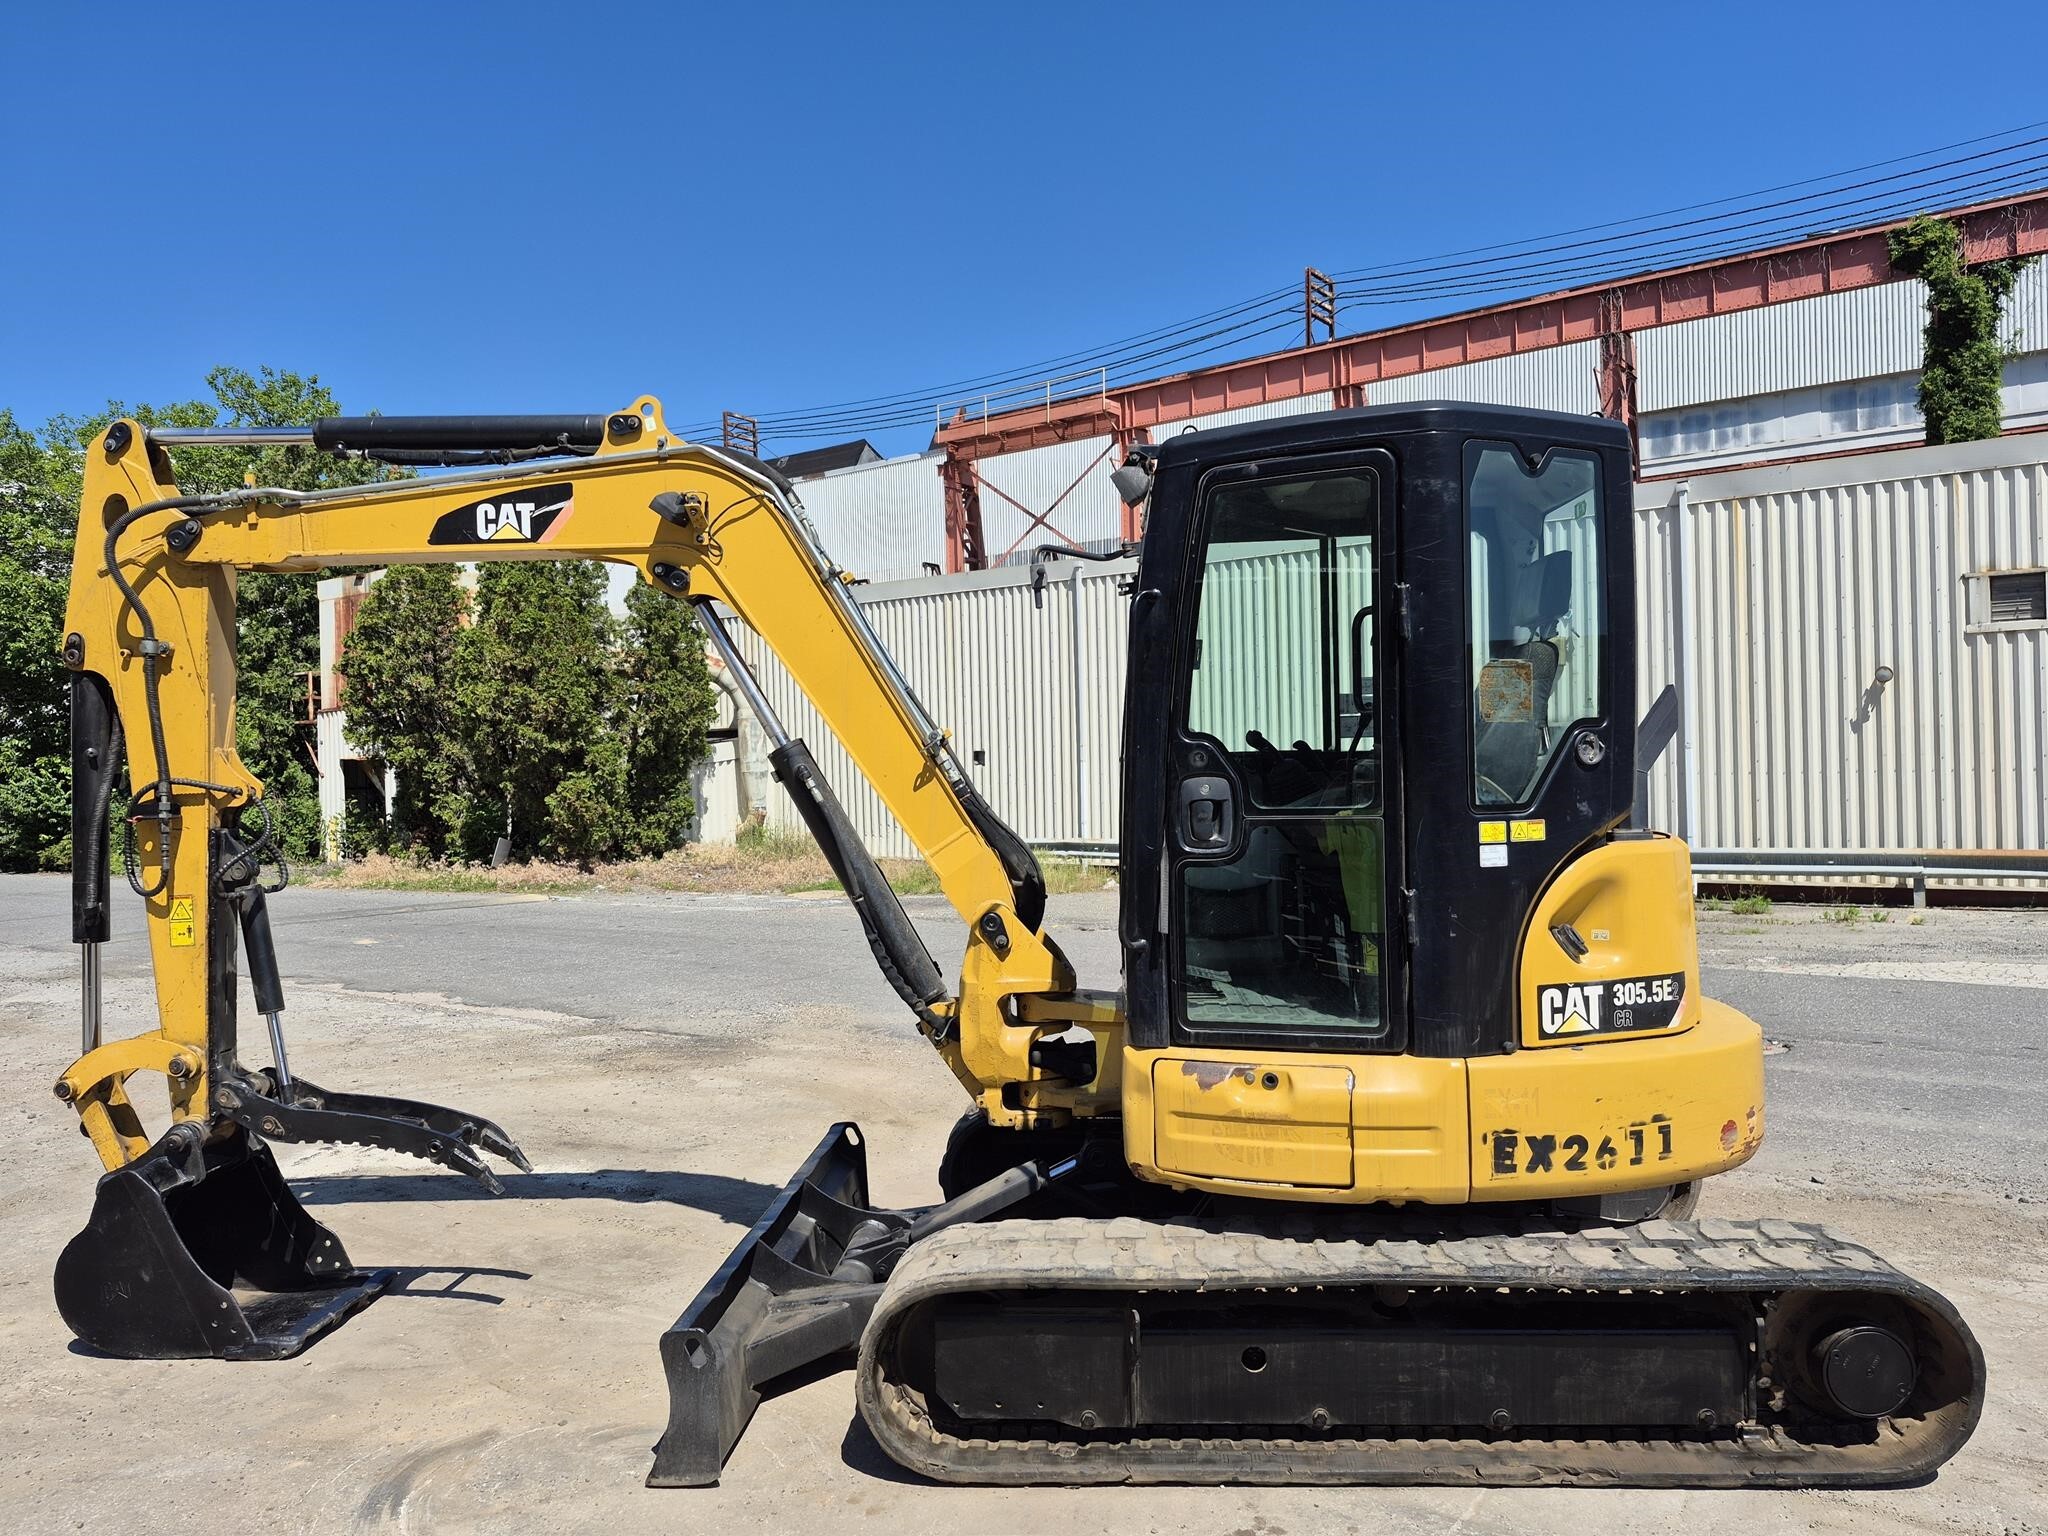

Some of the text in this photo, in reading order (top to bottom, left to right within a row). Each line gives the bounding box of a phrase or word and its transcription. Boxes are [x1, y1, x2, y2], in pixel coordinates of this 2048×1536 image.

[476, 502, 535, 540] CAT
[1541, 984, 1604, 1034] CAT
[1613, 1009, 1633, 1028] CR
[1493, 1124, 1672, 1174] EX2611
